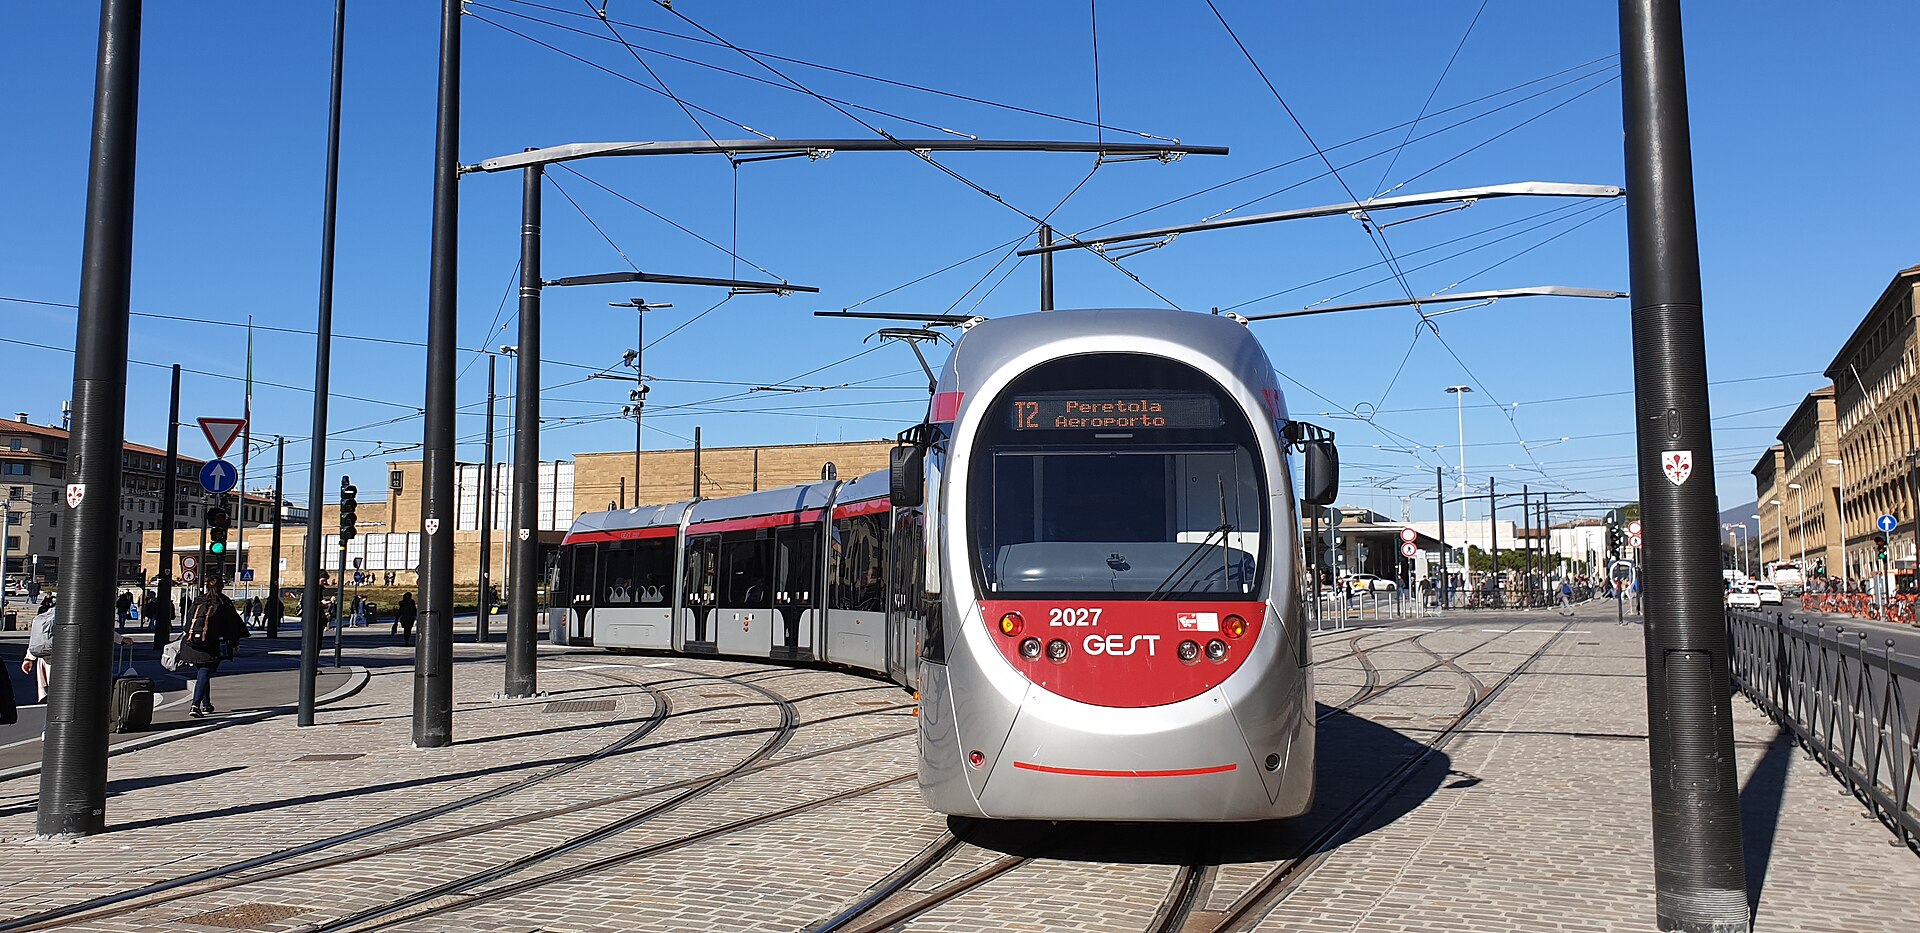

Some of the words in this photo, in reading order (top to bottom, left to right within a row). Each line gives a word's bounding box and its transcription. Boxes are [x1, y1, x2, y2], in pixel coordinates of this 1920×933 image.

[1014, 401, 1039, 428] T2
[1066, 400, 1162, 413] Peretola
[1055, 415, 1166, 427] Aeroporto
[1049, 608, 1103, 626] 2027
[1083, 635, 1161, 656] GEST
